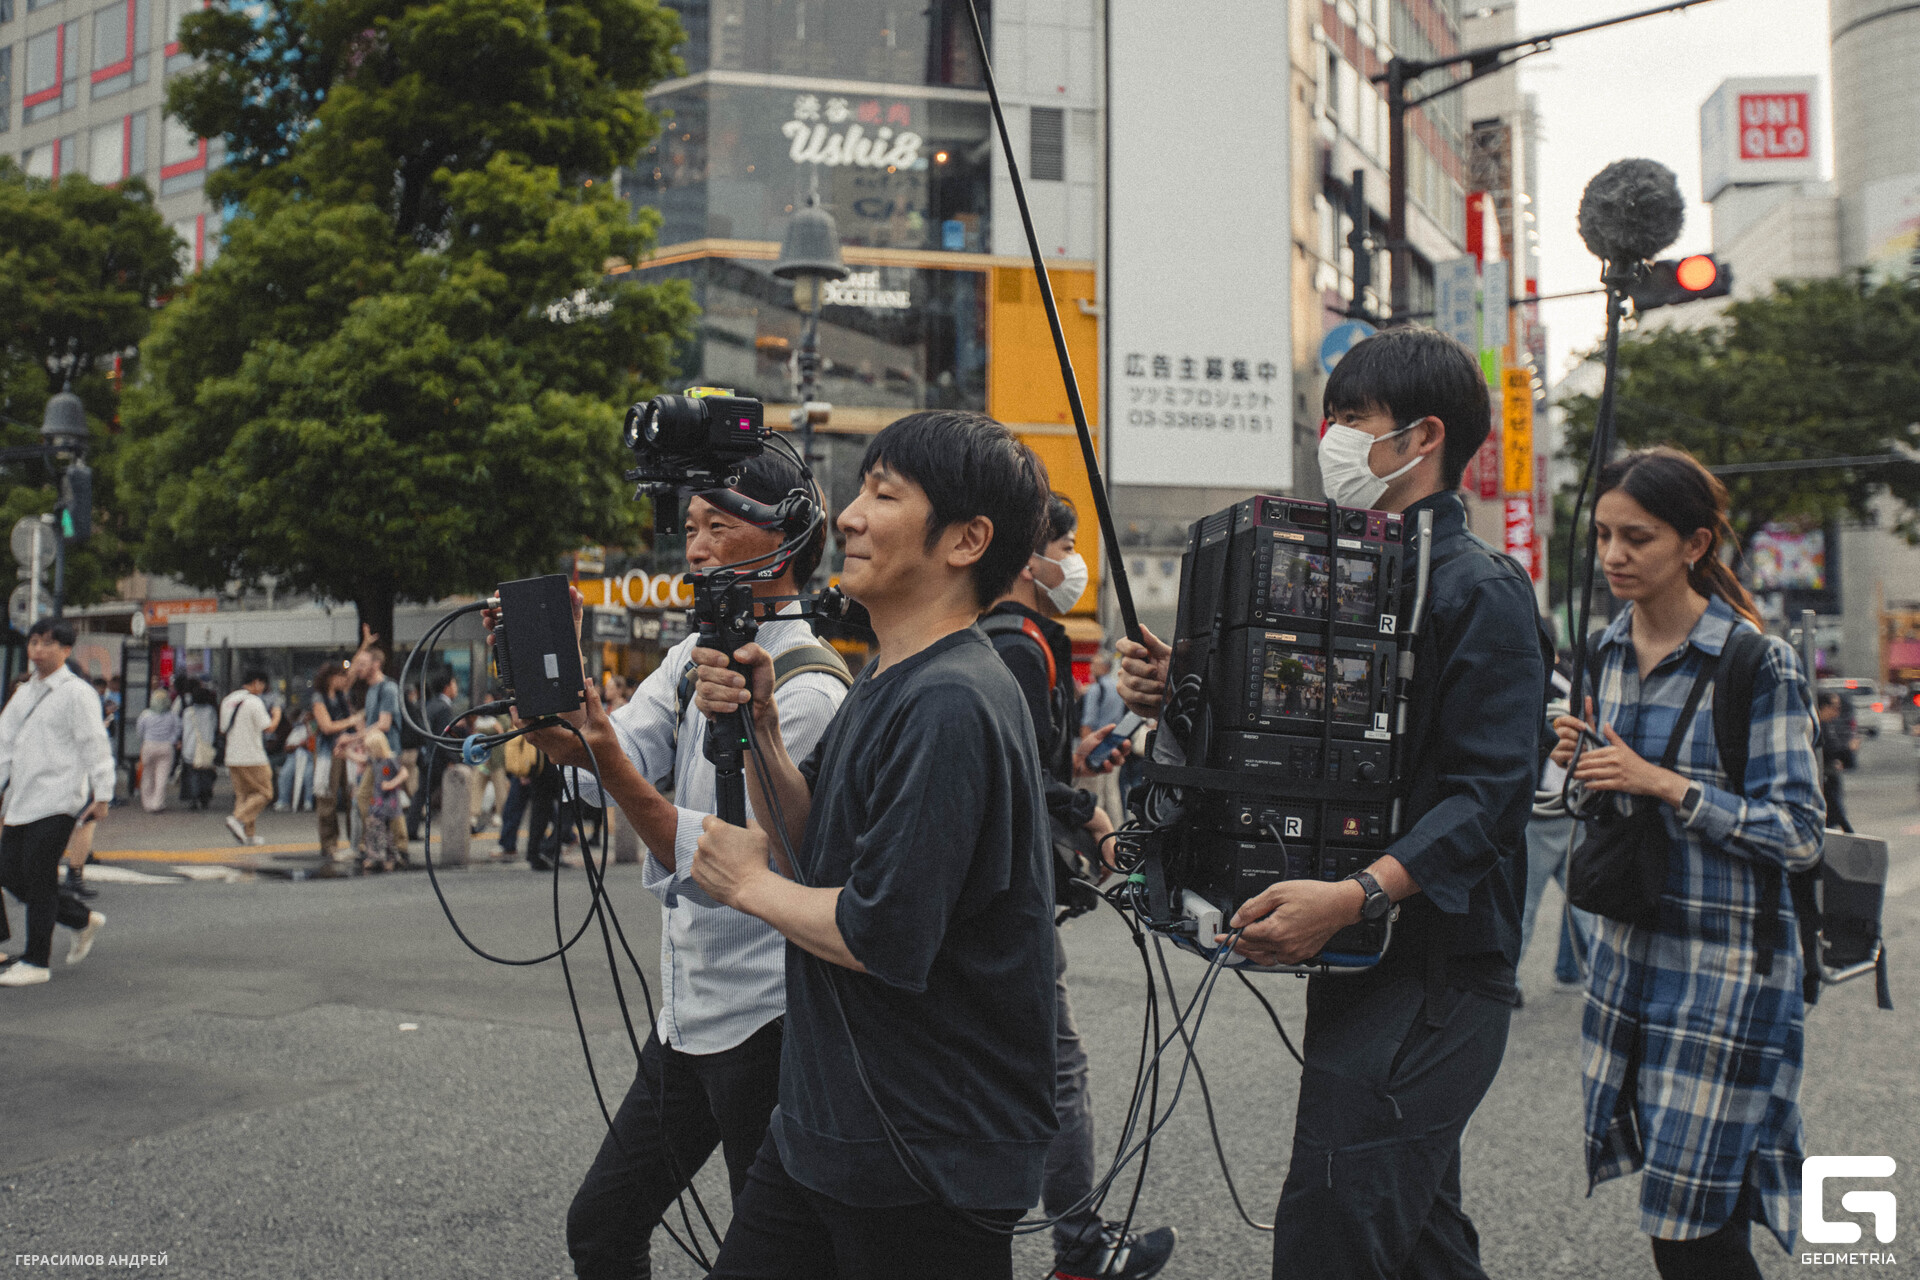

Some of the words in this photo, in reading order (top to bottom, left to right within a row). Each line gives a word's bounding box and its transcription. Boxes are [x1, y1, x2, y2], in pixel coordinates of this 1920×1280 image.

[1744, 98, 1799, 125] UNI
[782, 119, 923, 170] Ushi8
[1744, 127, 1804, 156] QLO
[1126, 353, 1277, 384] 広告主募集中
[1381, 616, 1394, 632] R
[1375, 715, 1386, 730] L
[1286, 819, 1299, 835] R
